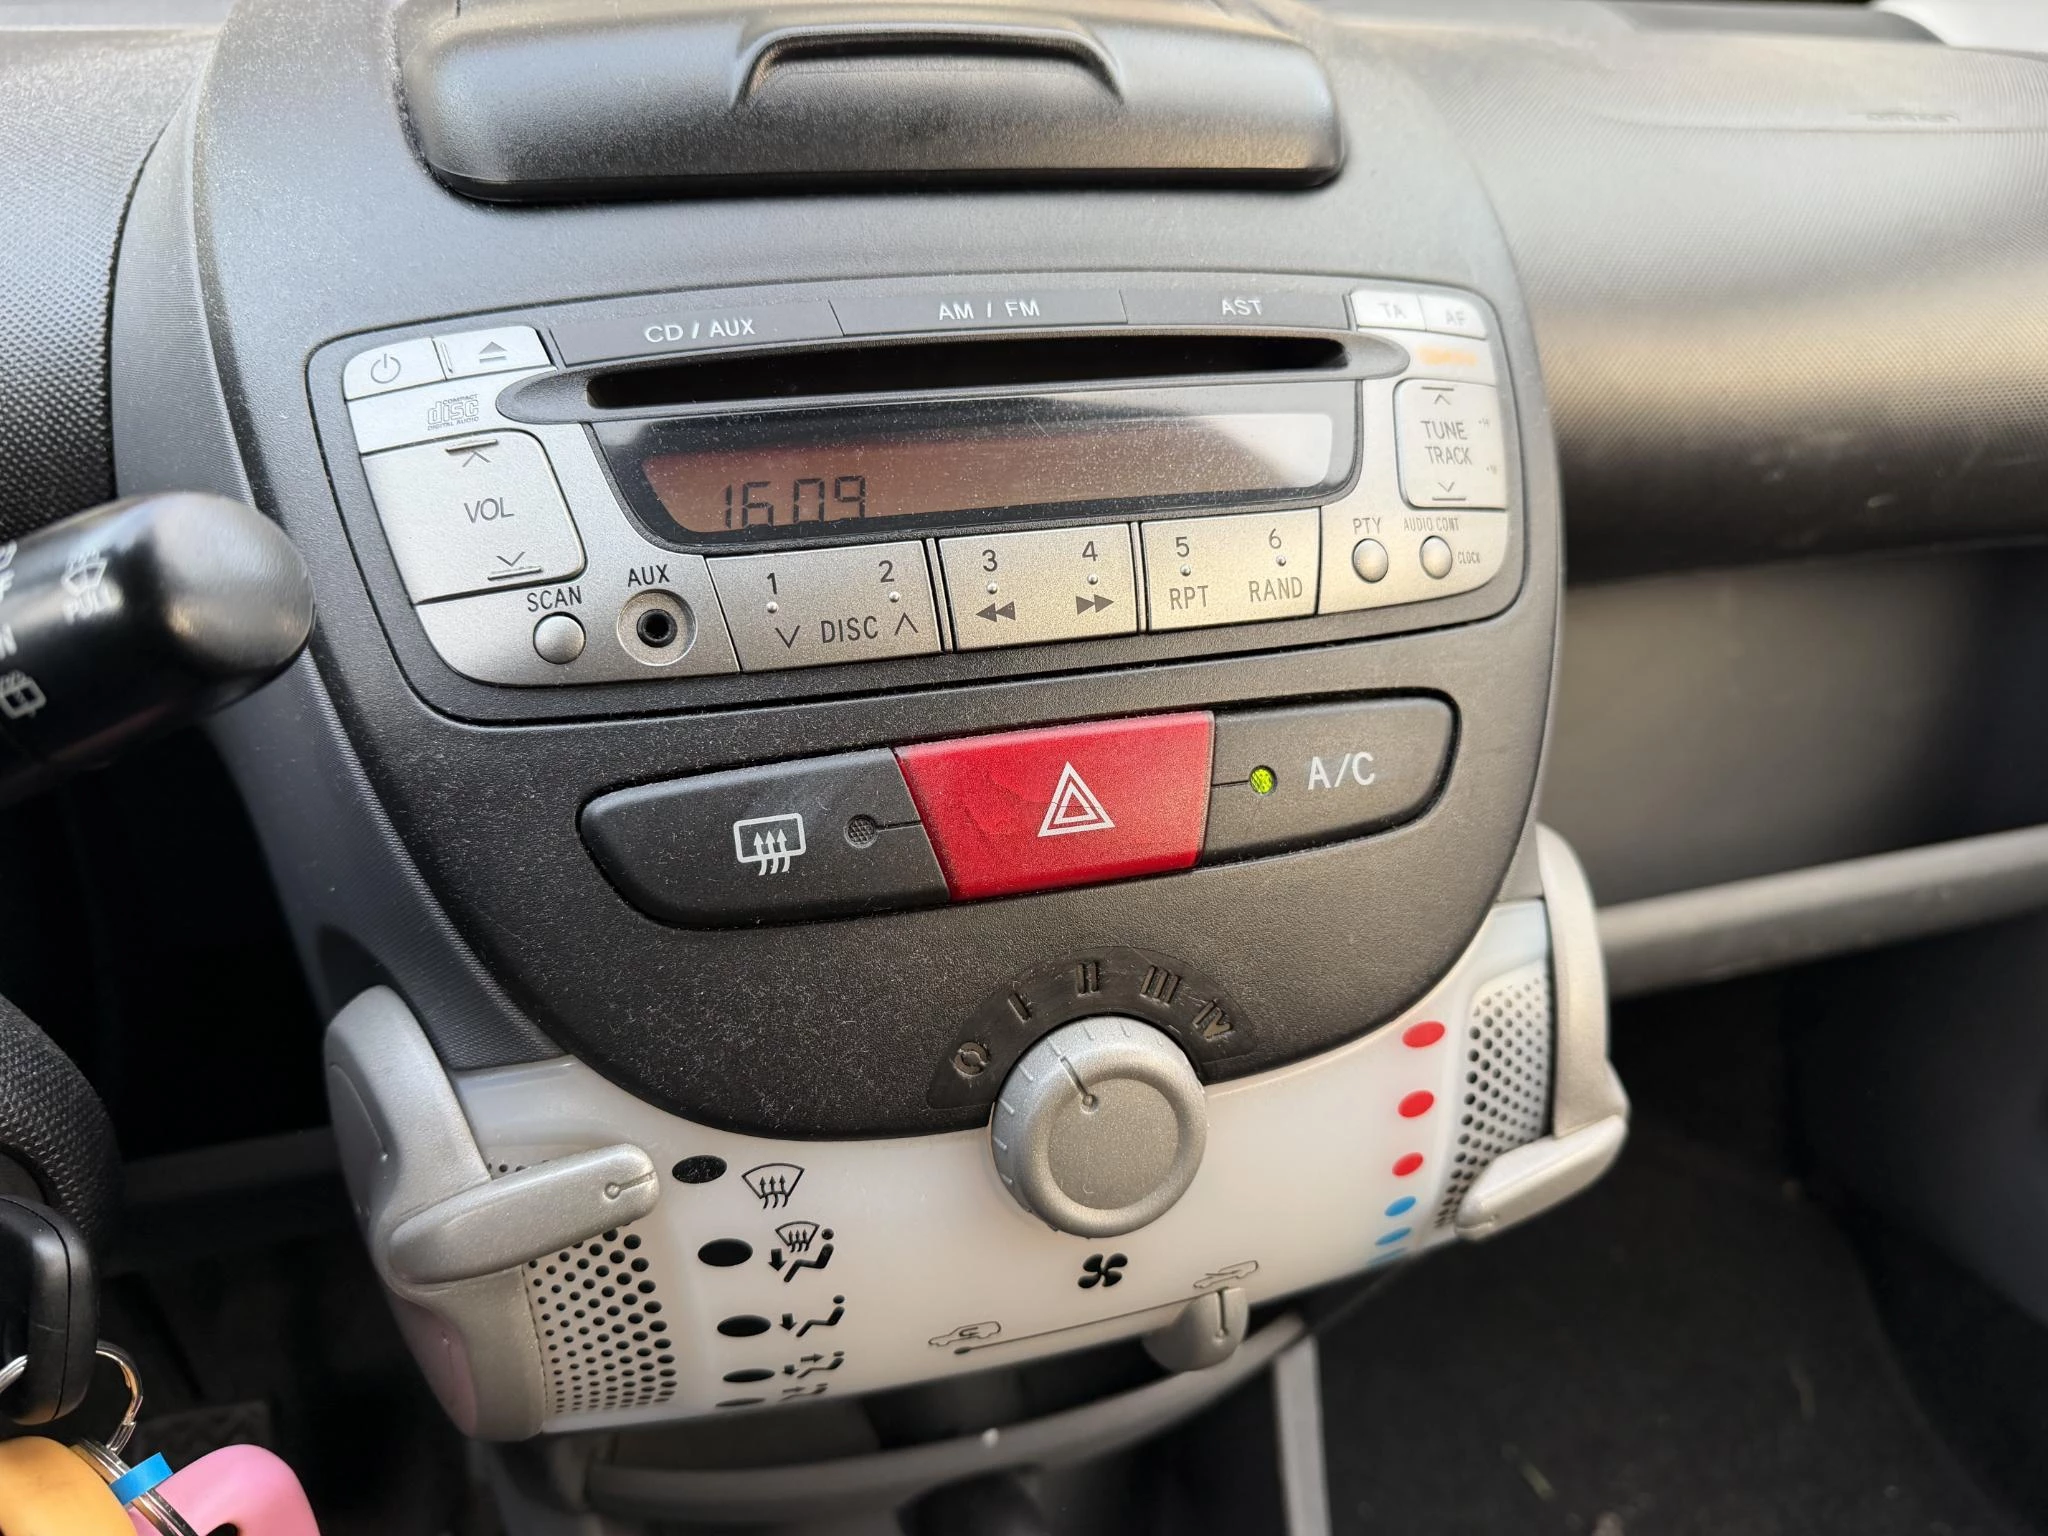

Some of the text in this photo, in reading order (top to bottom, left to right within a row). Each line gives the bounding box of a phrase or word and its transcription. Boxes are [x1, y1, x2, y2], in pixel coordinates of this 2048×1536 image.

[938, 302, 974, 321] AM
[1005, 299, 1040, 318] FM
[1221, 299, 1263, 316] AST
[1377, 302, 1407, 319] TA
[1445, 309, 1466, 326] AF
[644, 325, 684, 343] CD
[709, 318, 755, 338] AUX
[1420, 420, 1468, 440] TUNE
[1424, 446, 1473, 465] TRACK
[464, 497, 514, 523] VOL
[1353, 518, 1381, 534] PTY
[1403, 517, 1460, 532] AUDIO CONT
[1175, 536, 1190, 558] 5
[1268, 528, 1282, 549] 6
[982, 549, 998, 572] 3
[1081, 540, 1098, 562] 4
[1457, 551, 1481, 565] CLOCK
[627, 564, 670, 587] AUX
[878, 560, 895, 583] 2
[766, 572, 778, 595] 1
[1248, 576, 1303, 603] RAND
[527, 586, 582, 612] SCAN
[1170, 585, 1209, 610] RPT
[820, 615, 879, 644] DISC
[1307, 751, 1375, 790] A/C
